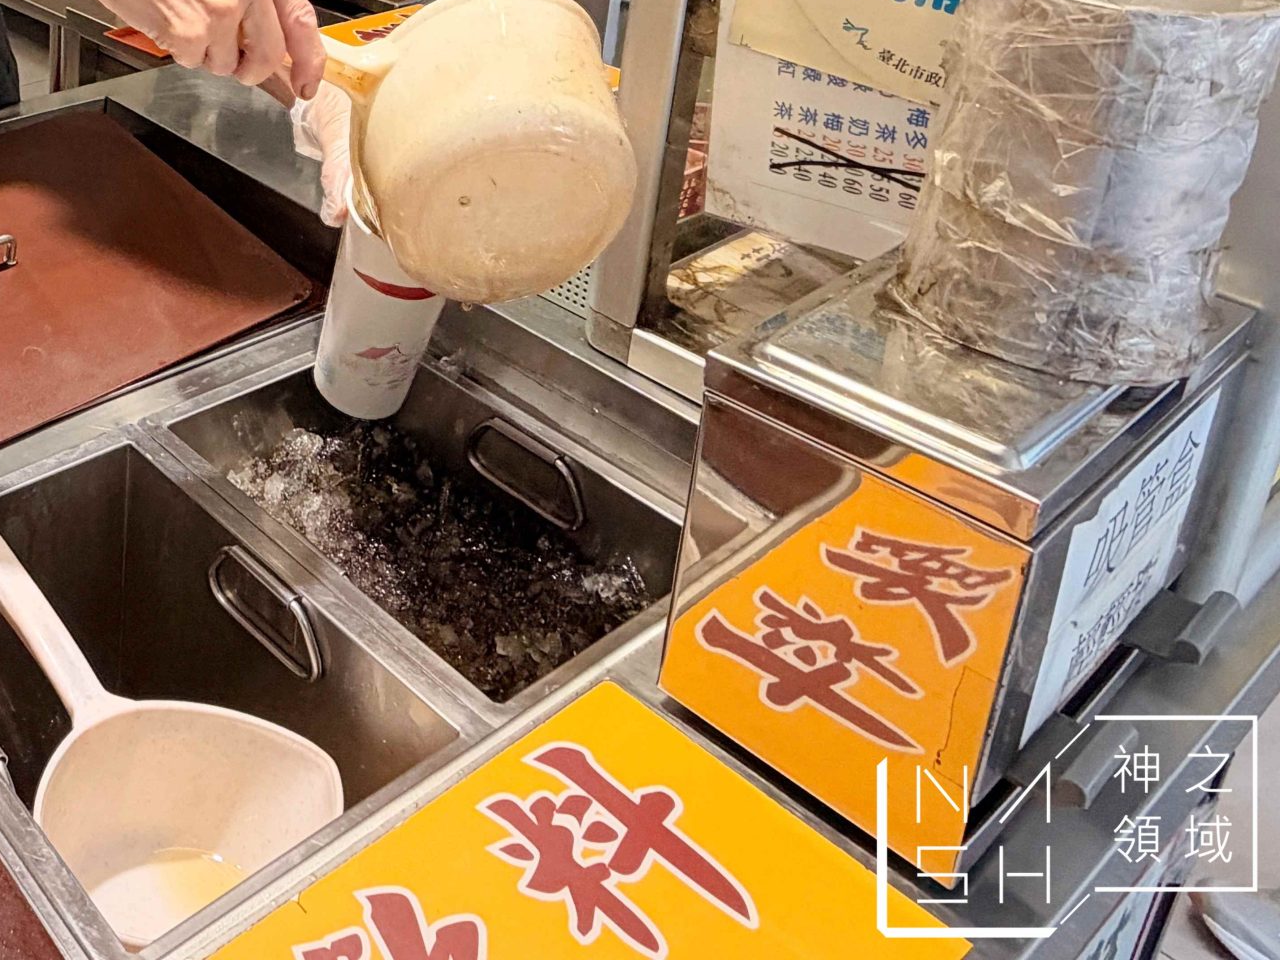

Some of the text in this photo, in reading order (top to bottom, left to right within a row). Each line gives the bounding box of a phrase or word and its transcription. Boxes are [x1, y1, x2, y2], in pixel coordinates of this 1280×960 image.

[878, 47, 947, 88] 臺北市政
[773, 101, 793, 120] 茶
[798, 106, 818, 126] 茶
[848, 116, 870, 137] 奶
[875, 122, 898, 144] 茶
[770, 141, 789, 158] 20
[847, 140, 867, 158] 30
[873, 146, 895, 165] 25
[817, 172, 837, 189] 40
[842, 178, 863, 196] 60
[869, 184, 889, 203] 50
[898, 192, 918, 210] 60
